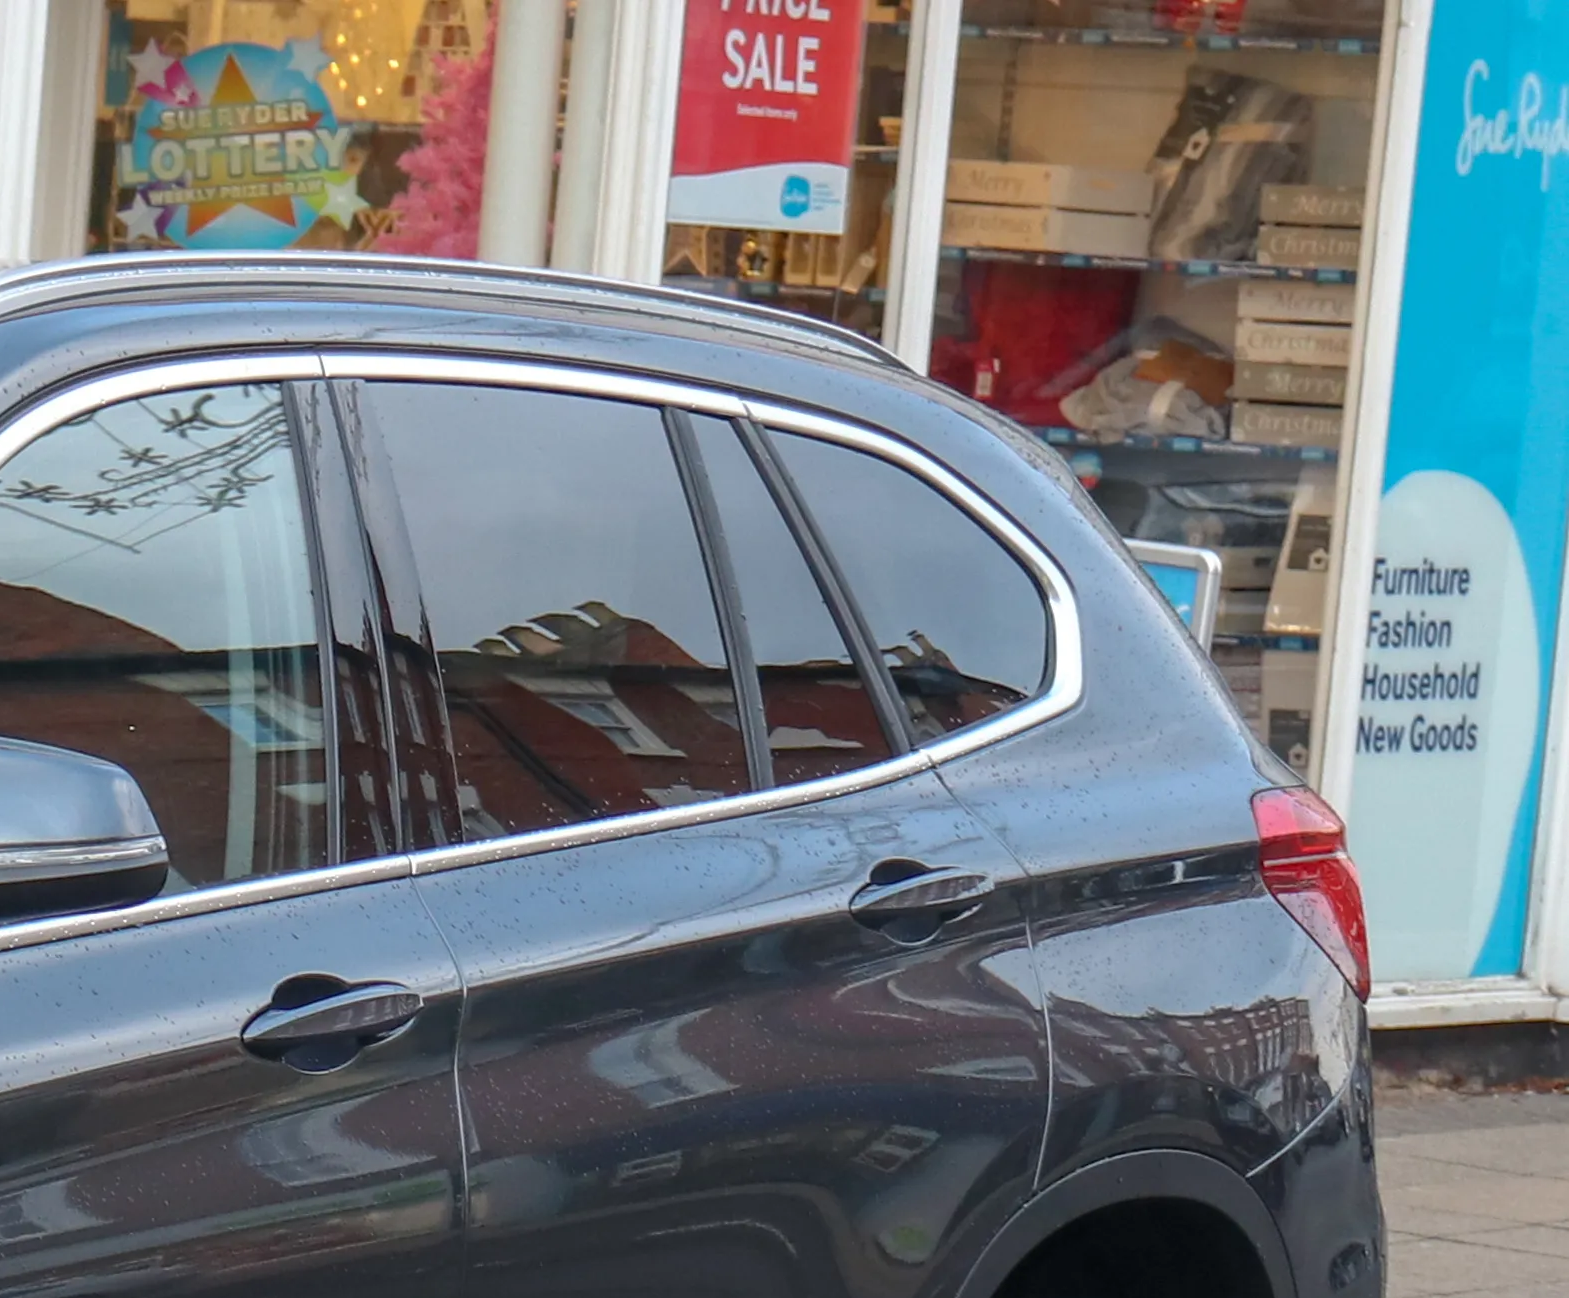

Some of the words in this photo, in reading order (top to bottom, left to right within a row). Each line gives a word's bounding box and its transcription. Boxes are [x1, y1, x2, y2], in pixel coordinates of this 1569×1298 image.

[722, 28, 821, 95] SALE
[160, 109, 213, 132] SUE
[216, 100, 309, 127] RYDER
[1514, 72, 1569, 192] Ryd
[119, 125, 351, 185] LOTTERY
[1371, 557, 1470, 596] Furniture
[1366, 610, 1452, 649] Fashion
[1361, 662, 1481, 701] Household
[1355, 716, 1405, 754] New
[1409, 714, 1478, 752] Goods
